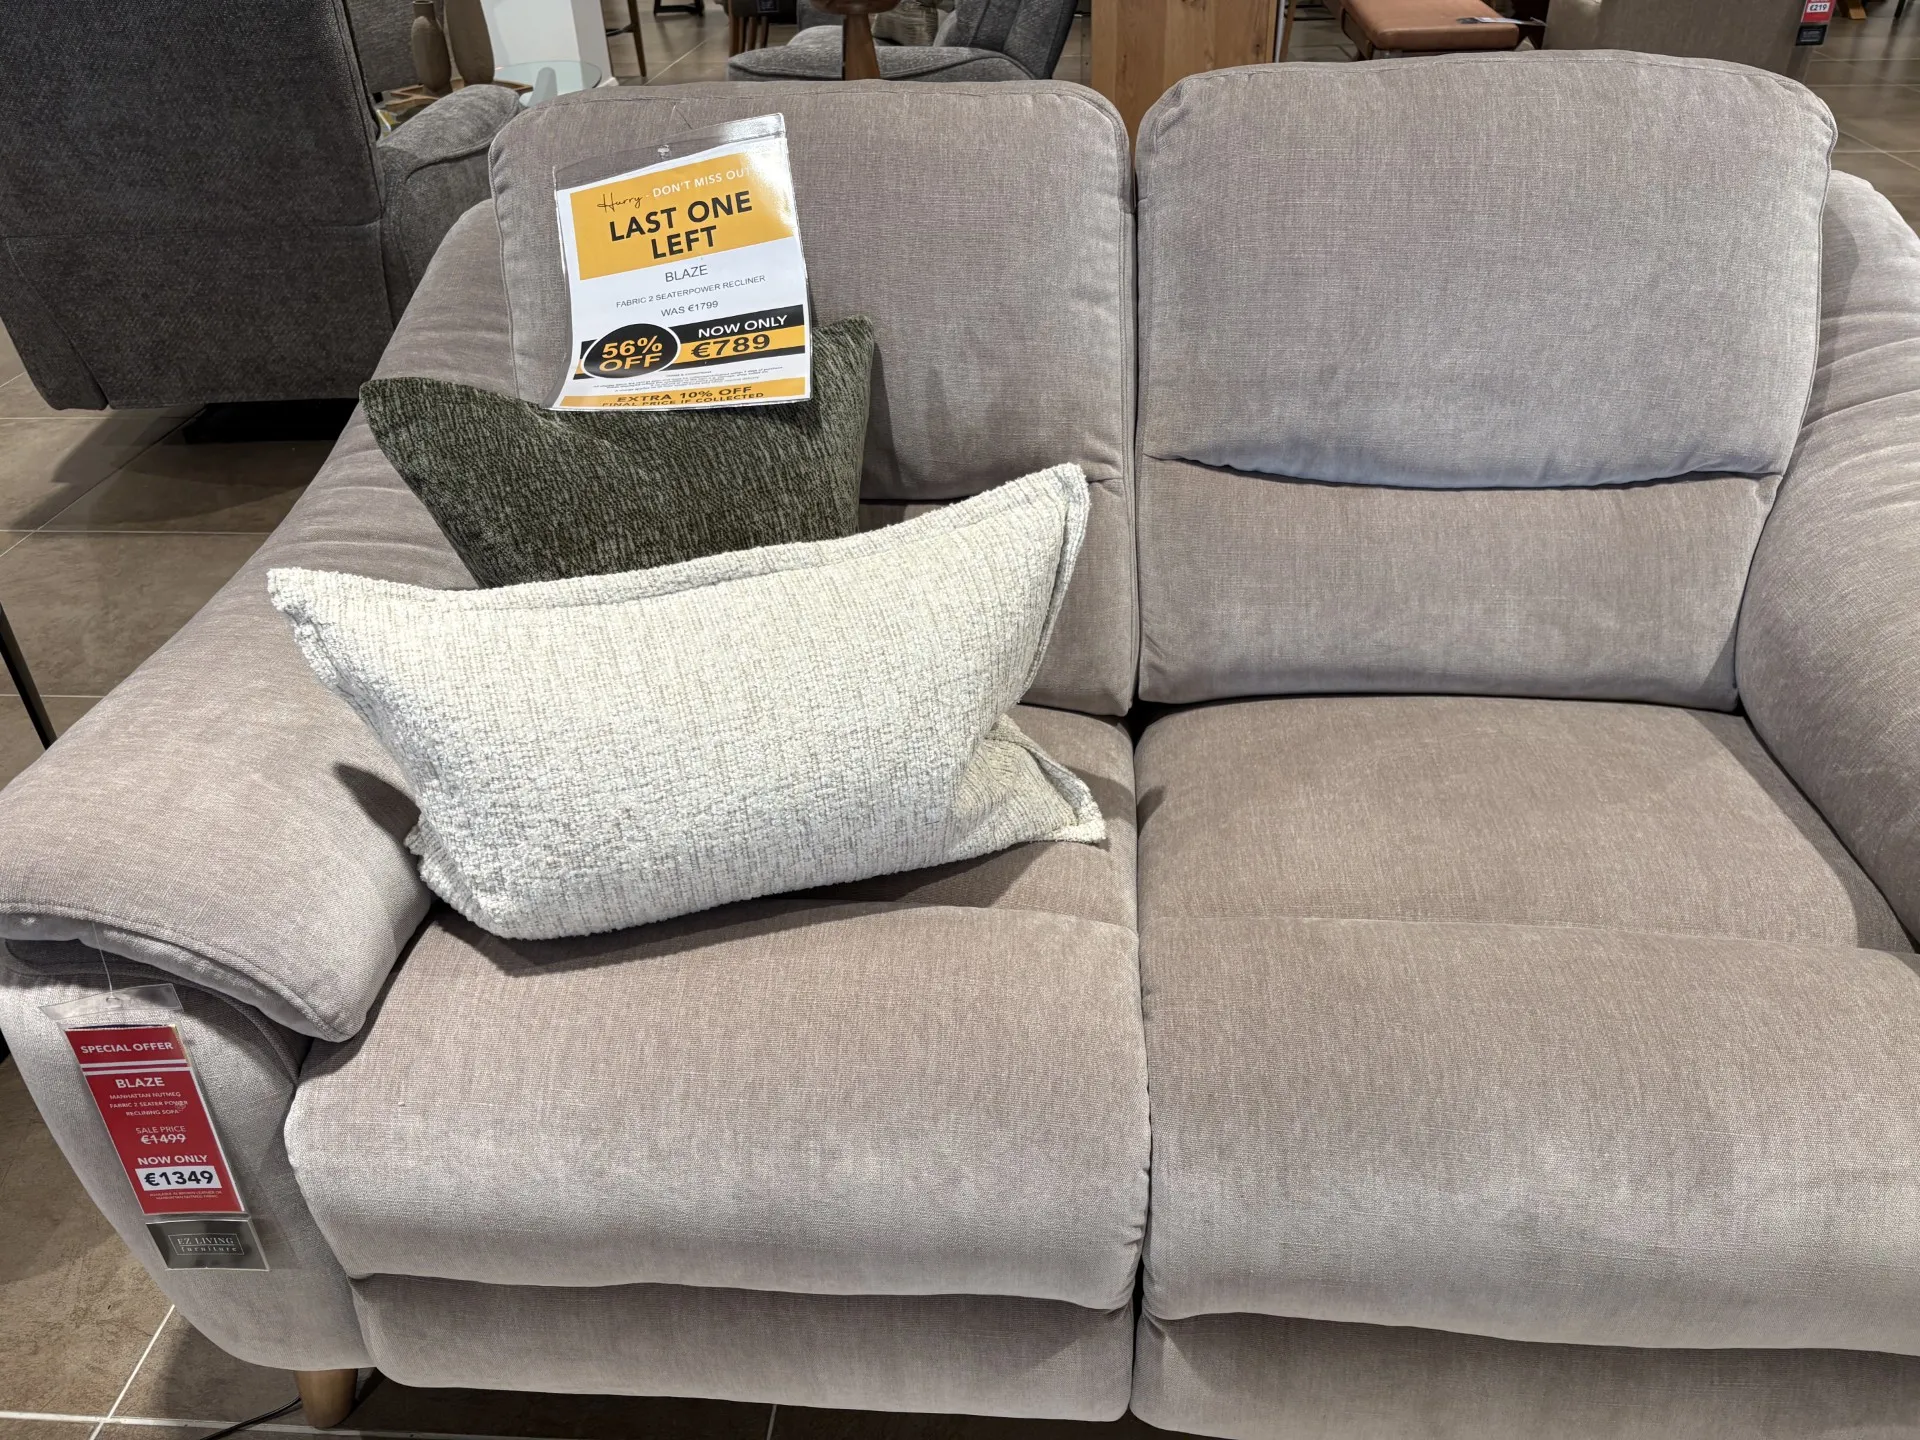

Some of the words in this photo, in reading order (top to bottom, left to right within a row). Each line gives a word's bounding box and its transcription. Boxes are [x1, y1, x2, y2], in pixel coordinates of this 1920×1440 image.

[597, 192, 643, 213] Hurry
[652, 181, 690, 198] DON'T
[694, 172, 722, 188] MISS
[609, 207, 677, 242] LAST
[687, 190, 752, 223] ONE
[651, 225, 717, 260] LEFT
[665, 264, 709, 282] BLAZE
[616, 297, 647, 308] FABRIC
[655, 283, 721, 301] SEATERPOWER
[722, 275, 766, 289] RECLINER
[661, 306, 685, 317] WAS
[688, 300, 719, 312] €1799
[698, 323, 741, 338] NOW
[744, 314, 788, 331] ONLY
[601, 335, 663, 359] 56%
[690, 333, 771, 359] €789
[599, 353, 662, 372] OFF
[616, 394, 672, 403] EXTRA
[680, 390, 713, 399] 10%
[718, 386, 752, 396] OFF
[695, 392, 764, 403] COLLECTED
[80, 1044, 131, 1054] SPECIAL
[132, 1042, 174, 1051] OFFER
[115, 1077, 165, 1089] BLAZE
[135, 1126, 159, 1134] SALE
[160, 1125, 187, 1133] PRICE
[141, 1133, 187, 1145] €1499
[137, 1155, 171, 1165] NOW
[174, 1154, 208, 1163] ONLY
[144, 1170, 214, 1187] €1349
[177, 1237, 192, 1245] EZ
[194, 1237, 234, 1245] LIVING
